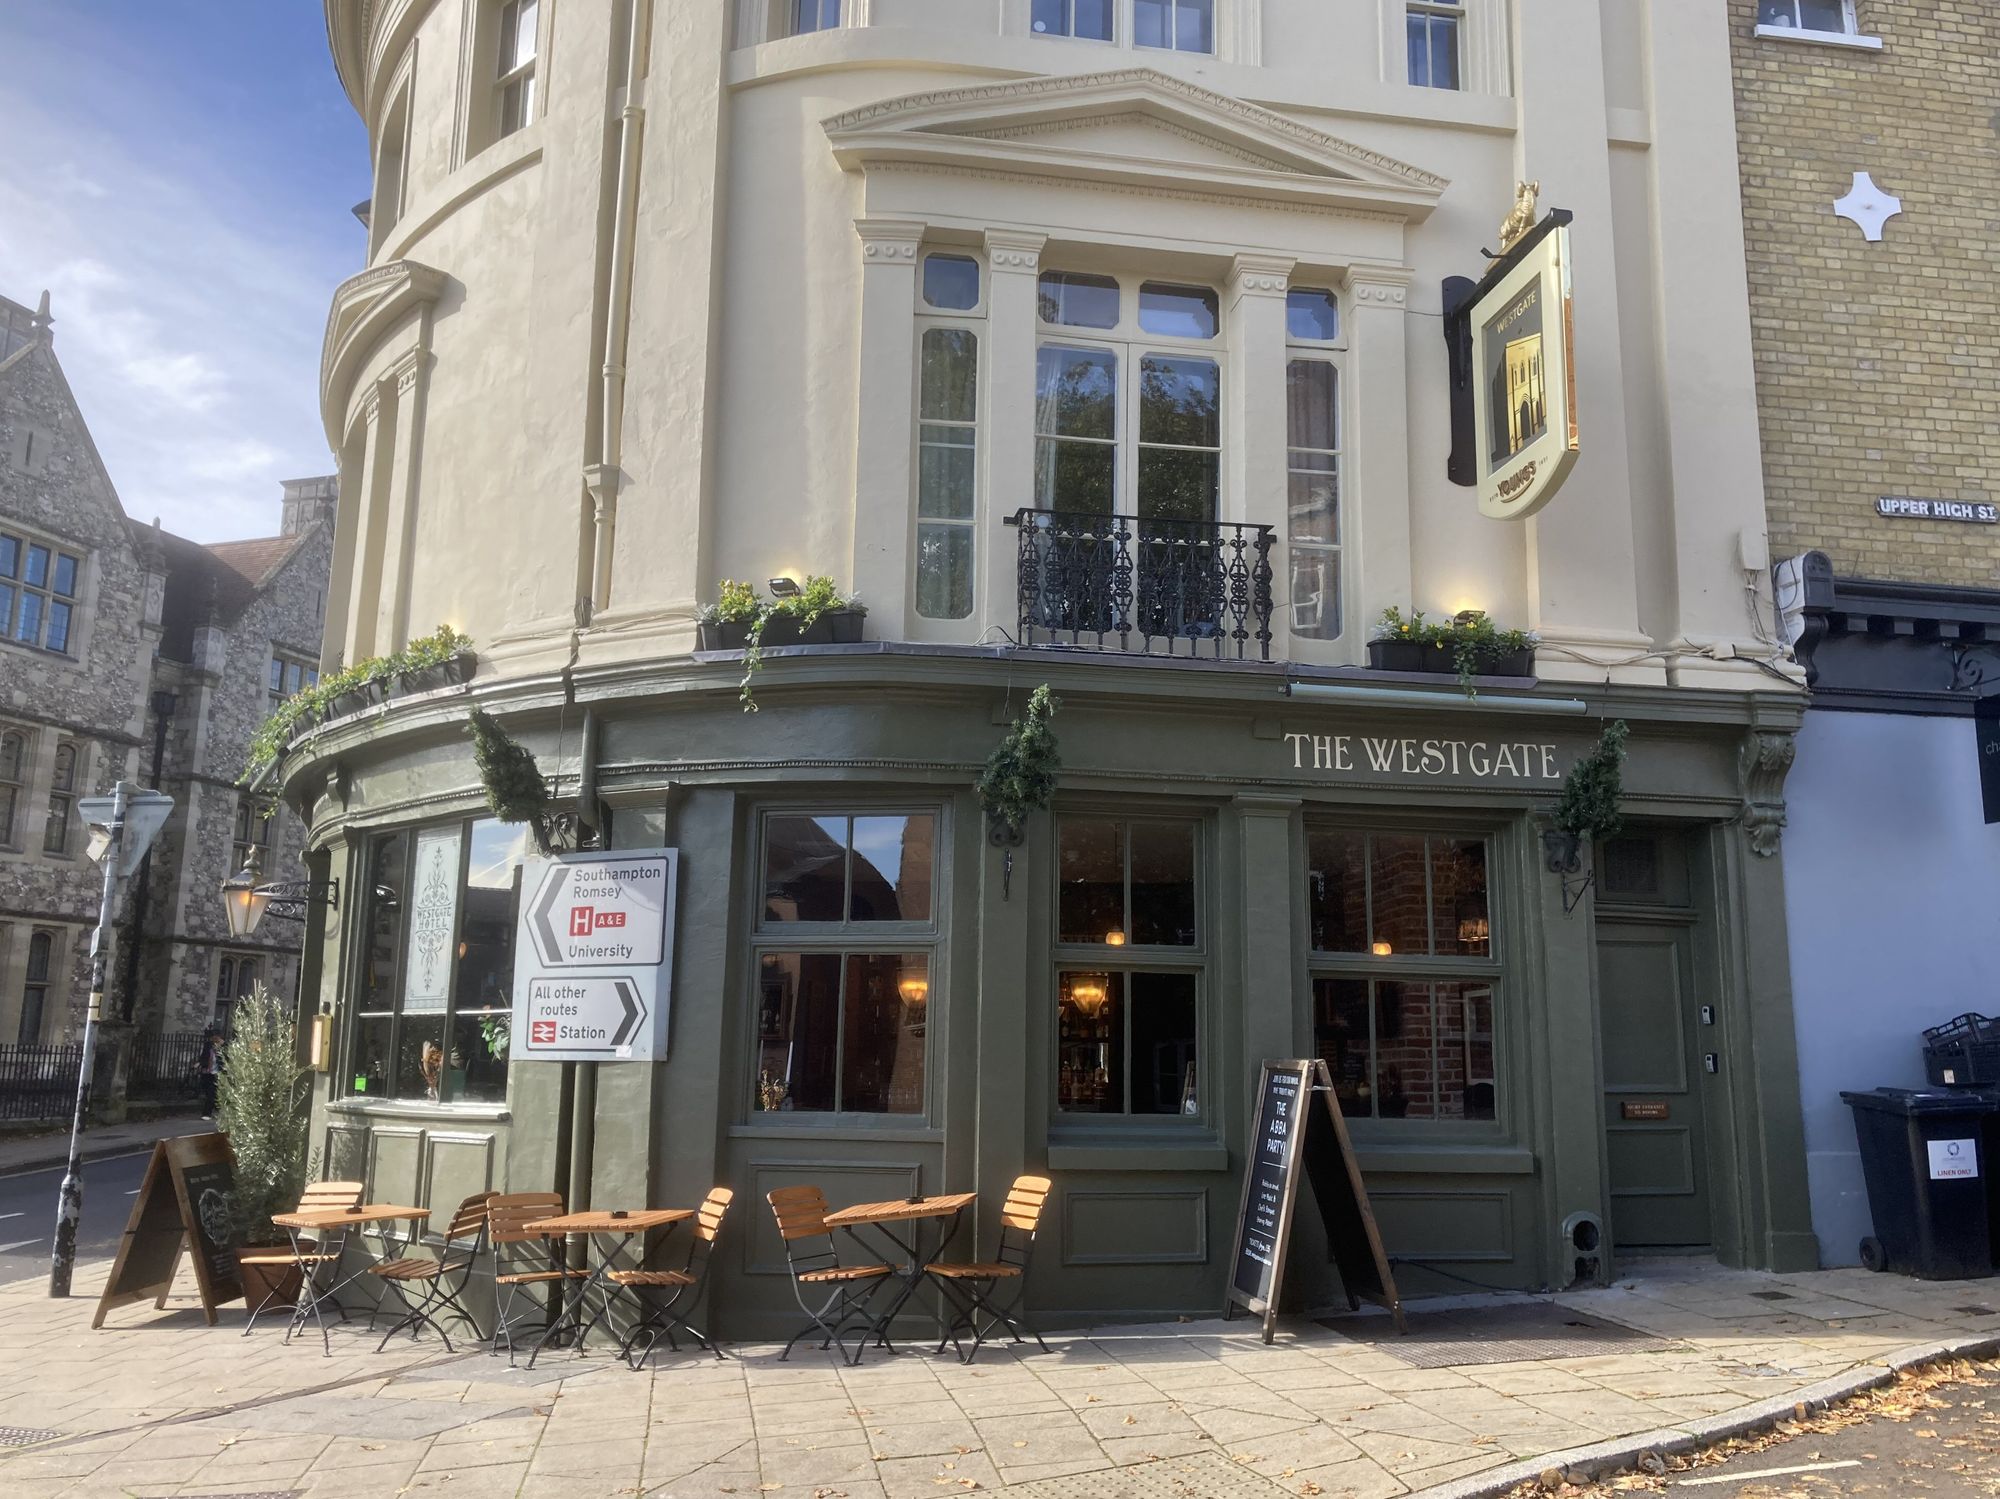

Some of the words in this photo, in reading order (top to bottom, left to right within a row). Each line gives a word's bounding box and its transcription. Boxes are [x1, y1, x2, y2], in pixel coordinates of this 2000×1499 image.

[1496, 290, 1537, 334] WESTGATE
[1879, 499, 1929, 515] UPPER
[1934, 501, 1973, 518] HIGH
[1283, 732, 1353, 771] THE
[1360, 737, 1561, 779] WESTGATE
[574, 866, 661, 882] Southampton
[573, 886, 622, 899] Romsey
[417, 906, 451, 919] WESTGATE
[418, 918, 447, 929] HOTEL
[573, 909, 590, 933] H
[568, 944, 633, 959] University
[534, 986, 551, 999] All
[554, 986, 587, 999] other
[540, 1003, 578, 1016] routes
[559, 1025, 606, 1039] Station
[1276, 1101, 1287, 1116] THE
[1269, 1119, 1287, 1136] ABBA
[1266, 1138, 1287, 1156] PARTY!
